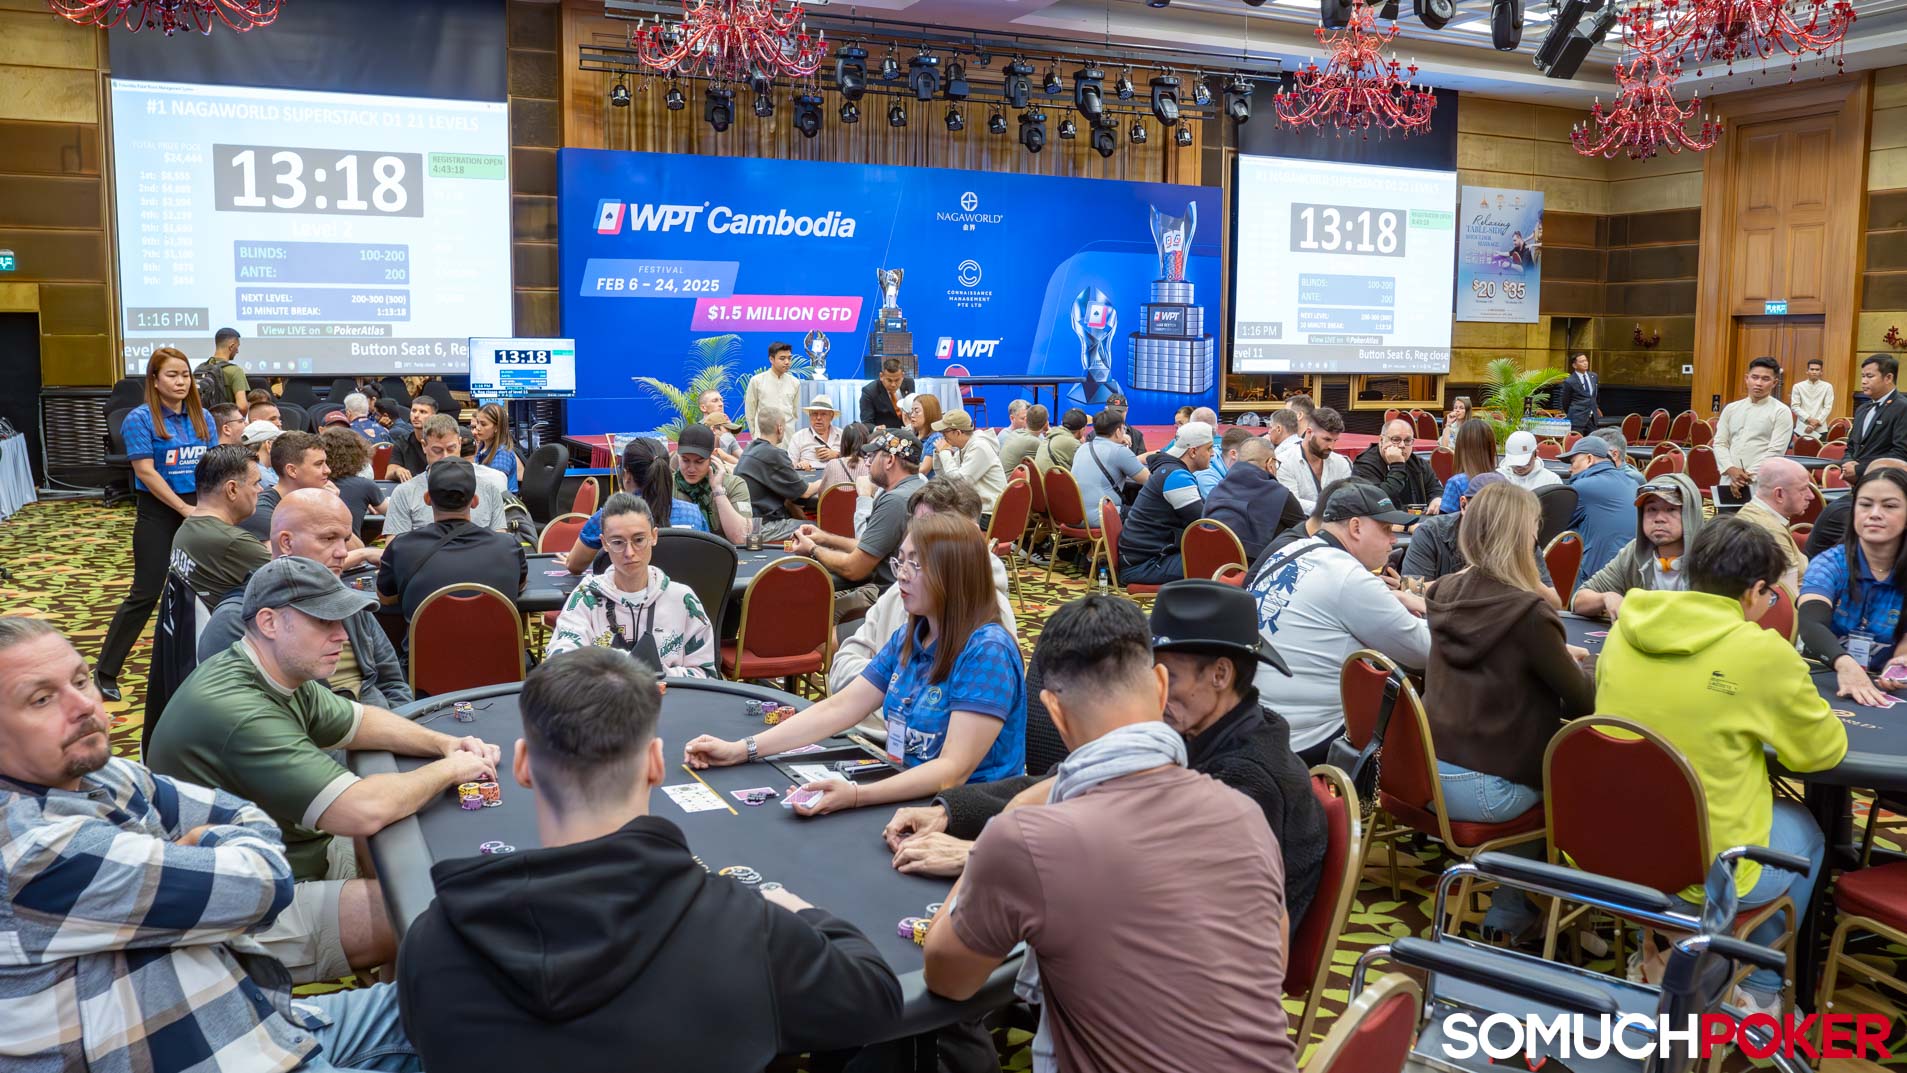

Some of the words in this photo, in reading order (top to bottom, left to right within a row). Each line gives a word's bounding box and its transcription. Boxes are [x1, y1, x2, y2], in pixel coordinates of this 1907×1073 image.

[146, 99, 167, 116] #1
[171, 101, 280, 122] NAGAWORLD
[283, 105, 379, 127] SUPERSTACK
[407, 113, 425, 129] 21
[429, 115, 480, 132] LEVELS
[432, 155, 482, 166] REGISTRATION
[484, 157, 504, 167] OPEN
[432, 164, 465, 175] 4:43:18
[231, 149, 409, 213] 13:18
[629, 203, 704, 233] WPT
[707, 206, 857, 238] Cambodia
[936, 211, 1002, 224] NAGAWORLD
[1300, 207, 1398, 254] 13:18
[240, 246, 287, 261] BLINDS:
[360, 249, 406, 263] 100-200
[240, 265, 277, 279] ANTE:
[384, 267, 406, 281] 200
[638, 265, 685, 275] FESTIVAL
[596, 278, 625, 291] FEB
[628, 278, 639, 291] 6
[655, 278, 679, 294] 24,
[682, 279, 720, 293] 2025
[1302, 278, 1328, 288] BLINDS:
[1367, 280, 1393, 290] 100-200
[1473, 279, 1496, 298] $20
[1503, 279, 1526, 299] $35
[241, 293, 266, 303] NEXT
[267, 293, 293, 304] LEVEL:
[351, 294, 384, 304] 200-300
[385, 294, 407, 306] (300)
[1381, 295, 1393, 304] 200
[241, 306, 252, 316] 10
[254, 306, 290, 316] MINUTE
[291, 307, 321, 317] BREAK:
[708, 304, 742, 321] $1.5
[746, 306, 814, 321] MILLION
[817, 307, 853, 322] GTD
[1161, 311, 1180, 321] WPT
[137, 313, 171, 327] 1:16
[174, 313, 200, 327] PM
[262, 325, 285, 336] View
[286, 325, 308, 337] LIVE
[309, 327, 321, 337] on
[333, 325, 385, 337] PokerAtlas
[1241, 325, 1261, 336] 1:16
[1263, 325, 1277, 336] PM
[1310, 335, 1324, 344] View
[351, 343, 397, 357] Button
[401, 343, 432, 357] Seat
[435, 344, 447, 358] 6,
[450, 344, 468, 357] Re
[957, 339, 1000, 358] WPT
[1253, 347, 1263, 358] 11
[499, 350, 547, 363] 13:18
[1359, 349, 1385, 360] Button
[1387, 350, 1404, 360] Seat
[1405, 350, 1413, 361] 6,
[1414, 350, 1429, 362] Reg
